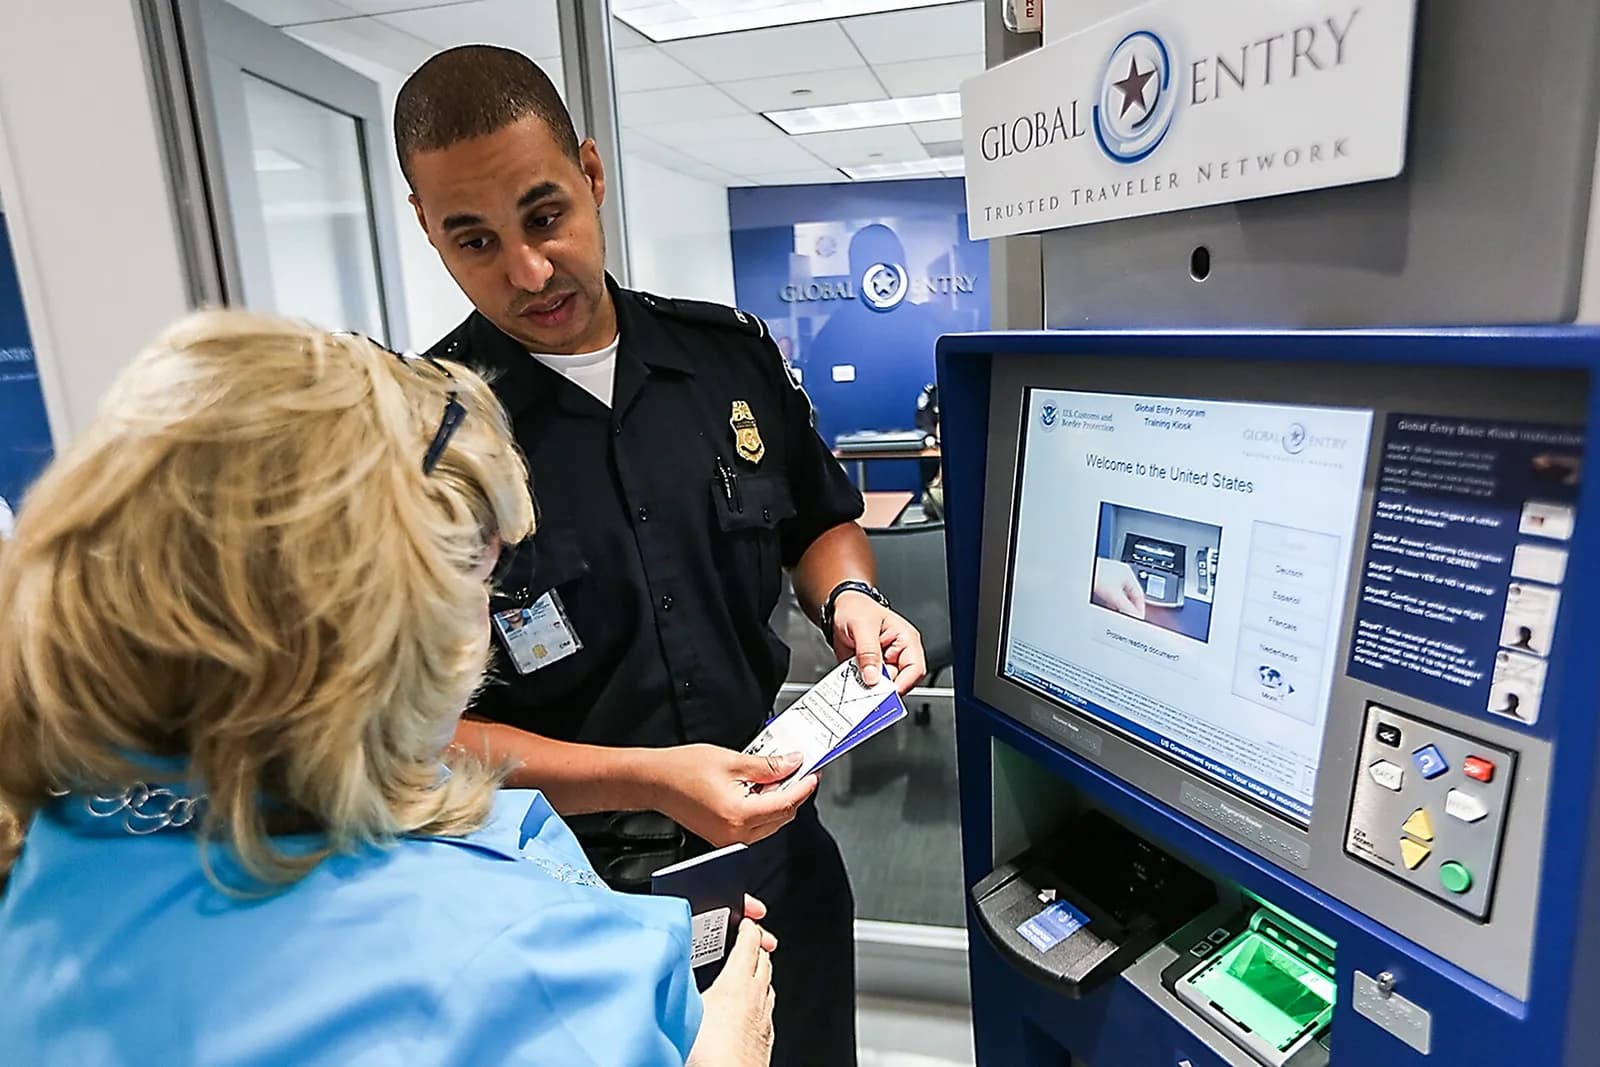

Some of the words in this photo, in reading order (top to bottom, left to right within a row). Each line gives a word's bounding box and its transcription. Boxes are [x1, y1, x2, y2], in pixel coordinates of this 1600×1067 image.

[981, 99, 1086, 162] GLOBAL
[1189, 8, 1362, 108] ENTRY
[984, 197, 1060, 222] TRUSTED
[1071, 171, 1180, 207] TRAVELER
[1197, 137, 1350, 185] NETWORK
[779, 279, 857, 304] GLOBAL
[911, 275, 978, 297] NTRY
[1134, 403, 1155, 414] Global
[1156, 405, 1175, 417] Entry
[1176, 407, 1206, 419] Program
[1144, 417, 1170, 430] Training
[1172, 420, 1192, 431] Kiosk
[1398, 420, 1428, 432] Global
[1429, 423, 1455, 435] Entry
[1457, 425, 1485, 438] Basic
[1085, 452, 1133, 475] Welcome
[1135, 461, 1146, 476] to
[1149, 463, 1167, 481] the
[1169, 466, 1208, 487] United
[1212, 472, 1254, 495] States
[1425, 543, 1457, 556] Customs
[1426, 551, 1445, 563] NEXT
[1275, 564, 1304, 578] Deutsch
[1420, 572, 1436, 583] YES
[1444, 578, 1457, 587] NO
[1160, 738, 1170, 748] US
[1170, 742, 1204, 766] Government
[1204, 760, 1227, 777] system
[1232, 773, 1247, 786] Your
[1248, 780, 1268, 797] usage
[1268, 791, 1276, 800] is
